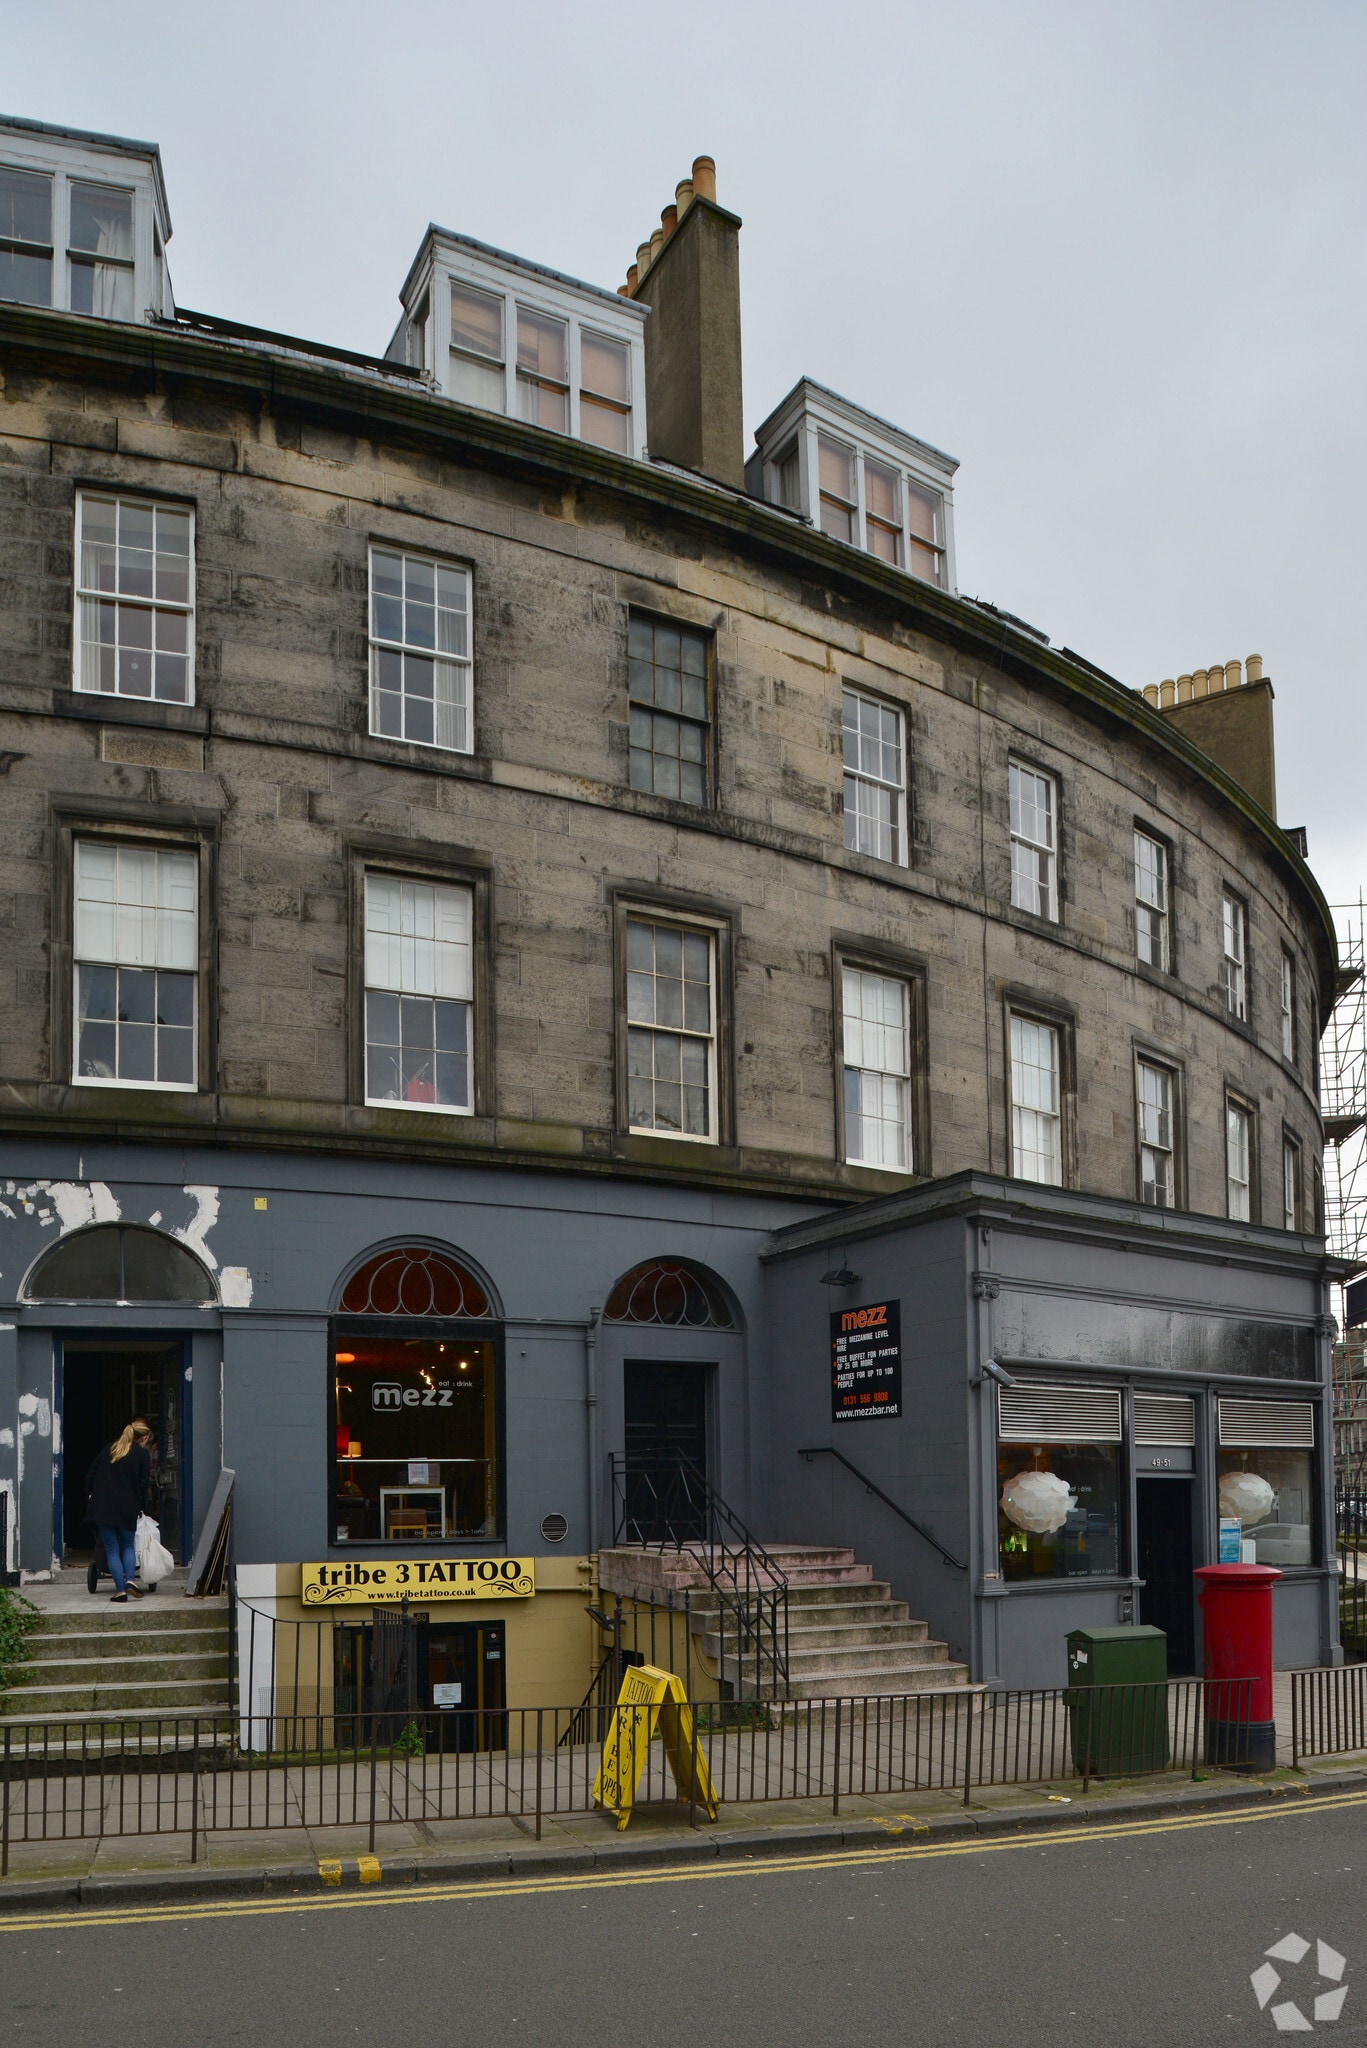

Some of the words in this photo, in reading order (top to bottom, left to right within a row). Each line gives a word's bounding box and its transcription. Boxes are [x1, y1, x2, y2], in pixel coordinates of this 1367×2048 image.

[841, 1306, 887, 1331] mezz
[875, 1330, 889, 1339] LEVEL
[837, 1355, 847, 1363] FREE
[849, 1352, 865, 1361] BUFFET
[879, 1347, 898, 1357] PARTIES
[860, 1359, 873, 1367] MORE
[837, 1372, 854, 1381] PARTIES
[857, 1371, 865, 1379] FOR
[876, 1368, 882, 1376] TO
[885, 1367, 893, 1375] 100
[838, 1380, 853, 1388] PEOPLE
[373, 1385, 453, 1408] mezz
[843, 1395, 856, 1406] 0131
[860, 1394, 870, 1403] 556
[835, 1403, 898, 1419] www.mezzbar.net
[318, 1563, 386, 1586] tribe
[395, 1563, 410, 1583] 3
[414, 1560, 522, 1583] TATTOO
[367, 1587, 477, 1600] www.tribetattoo.co.uk
[627, 1677, 654, 1704] TATTOO
